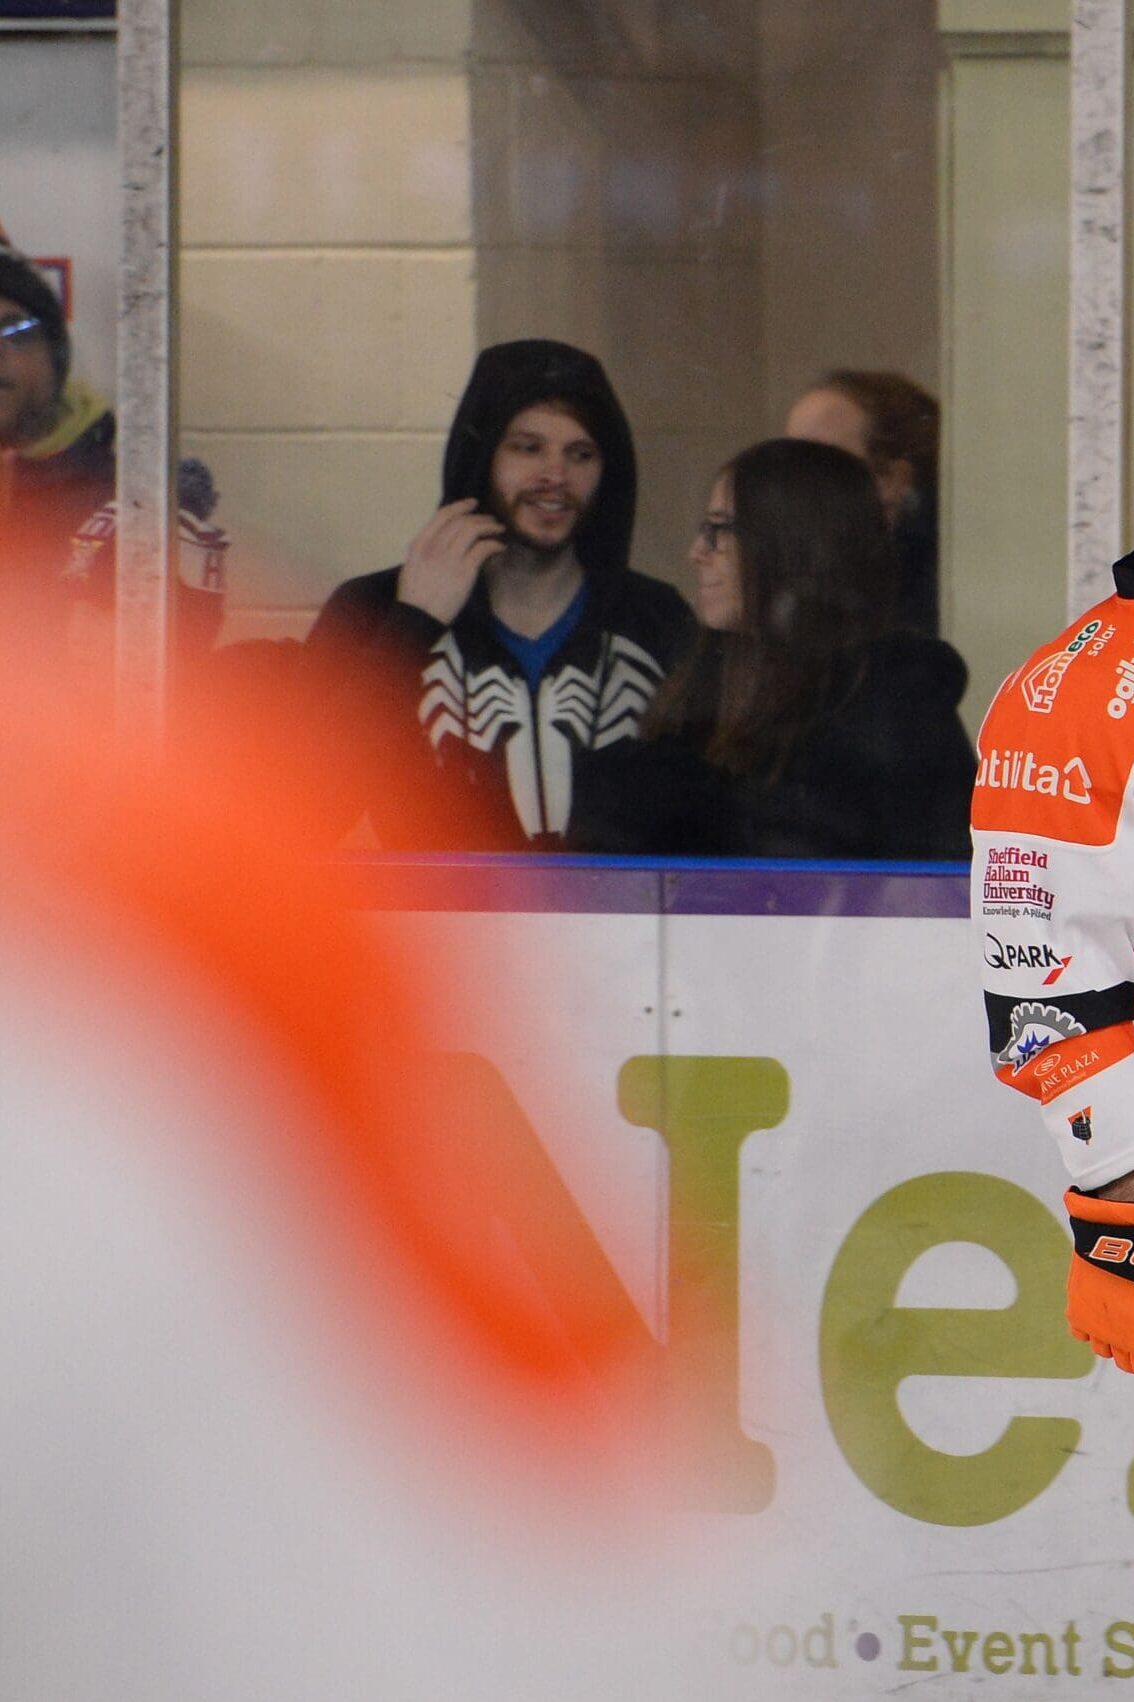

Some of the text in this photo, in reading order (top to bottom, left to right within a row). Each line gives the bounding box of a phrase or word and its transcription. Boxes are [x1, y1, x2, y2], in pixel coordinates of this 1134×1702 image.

[1087, 624, 1117, 657] solar
[988, 847, 1048, 869] Sheffield
[984, 866, 1030, 883] Hallam
[983, 883, 1055, 910] University
[1060, 1051, 1100, 1078] PLAZA
[726, 1612, 839, 1669] ood
[897, 1615, 1081, 1676] Event
